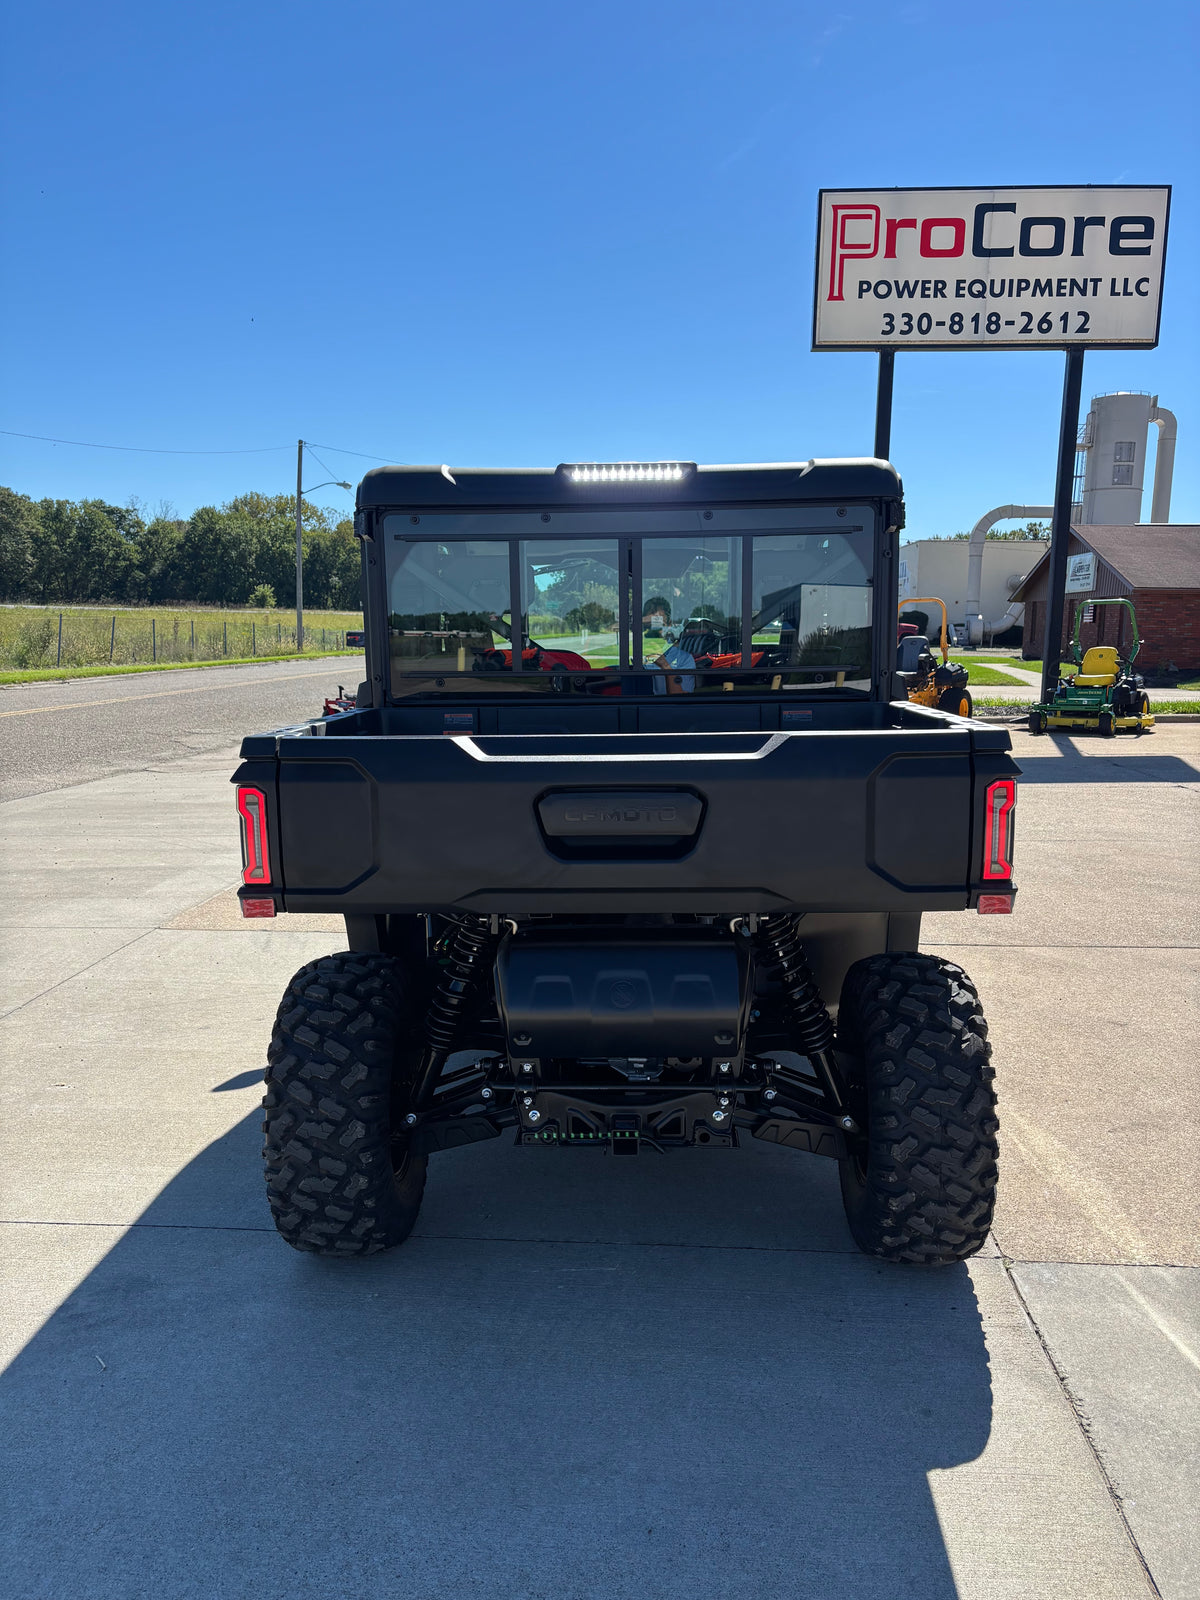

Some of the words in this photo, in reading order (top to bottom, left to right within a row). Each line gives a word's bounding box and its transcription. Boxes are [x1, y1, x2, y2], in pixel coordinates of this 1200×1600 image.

[827, 203, 1155, 301] ProCore
[858, 279, 947, 299] POWER
[955, 278, 1102, 299] EQUIPMENT
[1110, 277, 1150, 297] LLC
[881, 311, 1091, 336] 330-818-2612
